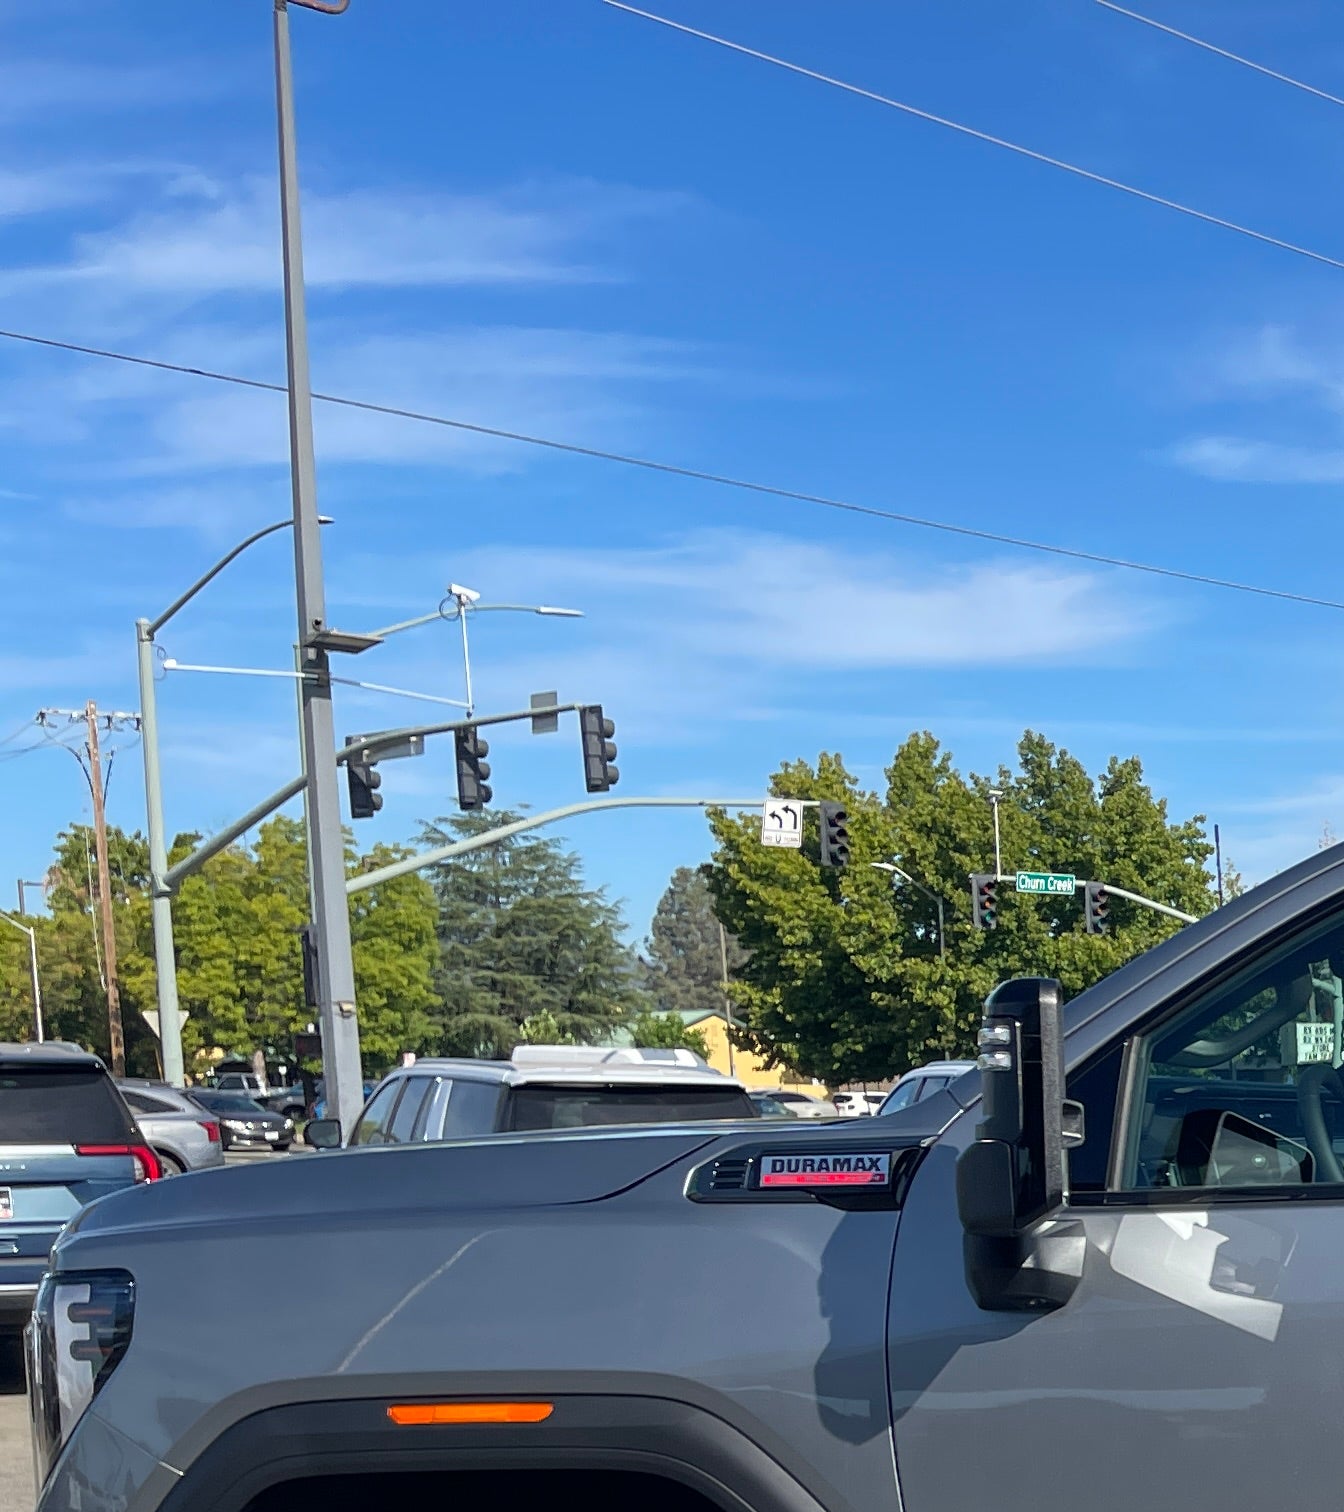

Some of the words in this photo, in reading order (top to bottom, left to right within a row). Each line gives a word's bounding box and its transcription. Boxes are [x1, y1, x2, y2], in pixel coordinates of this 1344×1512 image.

[1019, 874, 1046, 890] Churn
[1048, 876, 1073, 891] Creek
[770, 1157, 882, 1173] DURAMAX
